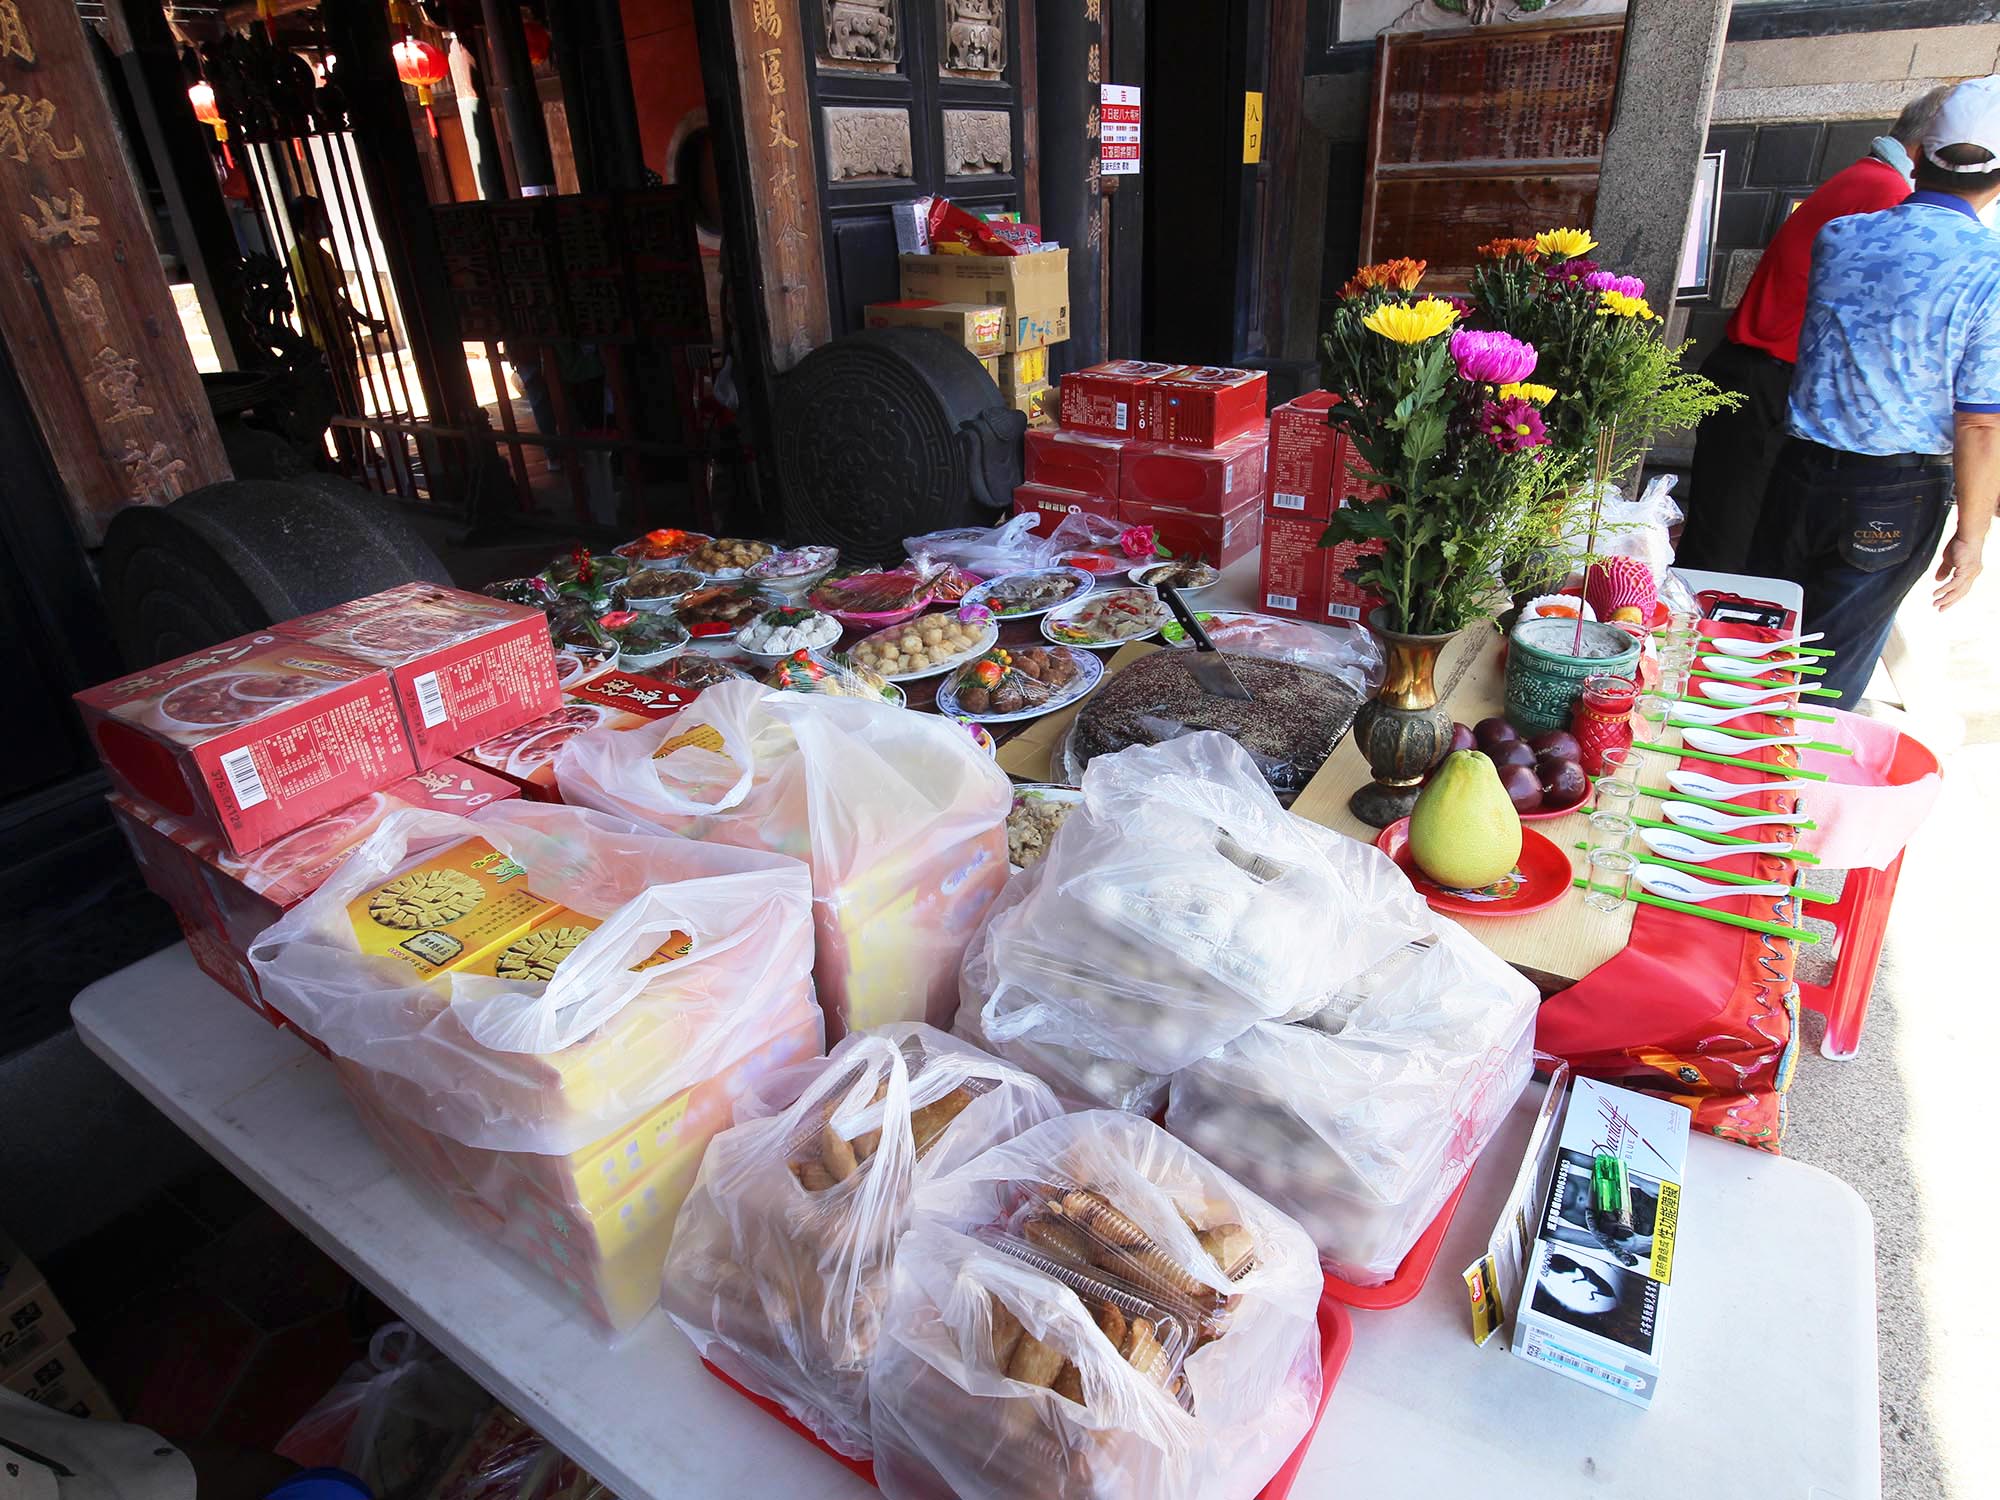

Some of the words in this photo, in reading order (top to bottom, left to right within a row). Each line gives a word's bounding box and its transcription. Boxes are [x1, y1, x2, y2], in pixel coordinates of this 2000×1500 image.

[1249, 104, 1260, 148] 入口
[1853, 530, 1902, 539] CUMAR
[1624, 1139, 1636, 1160] BLUE
